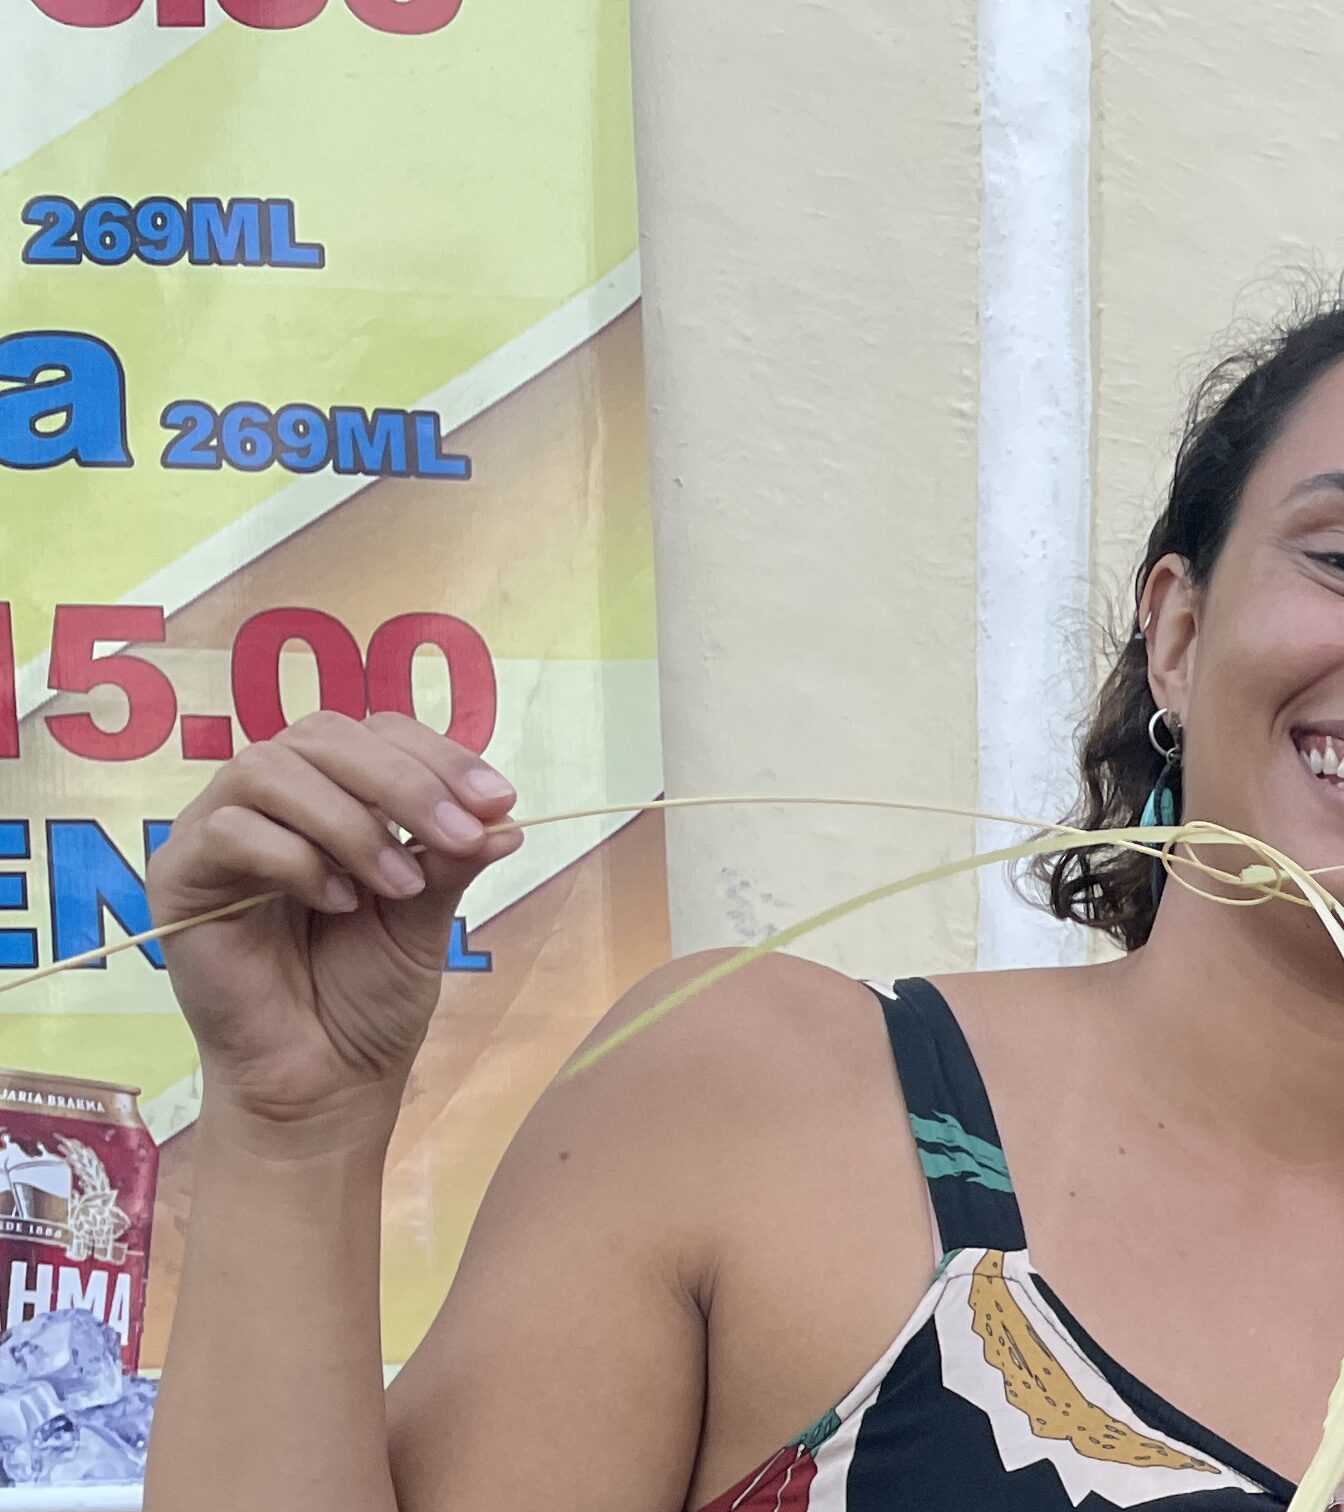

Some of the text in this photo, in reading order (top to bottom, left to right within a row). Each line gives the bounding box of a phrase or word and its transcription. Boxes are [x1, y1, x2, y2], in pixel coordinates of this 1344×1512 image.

[21, 196, 325, 268] 269ML
[160, 400, 472, 481] 269ML
[0, 603, 497, 763] 5.00
[47, 1094, 105, 1113] BRAHMA
